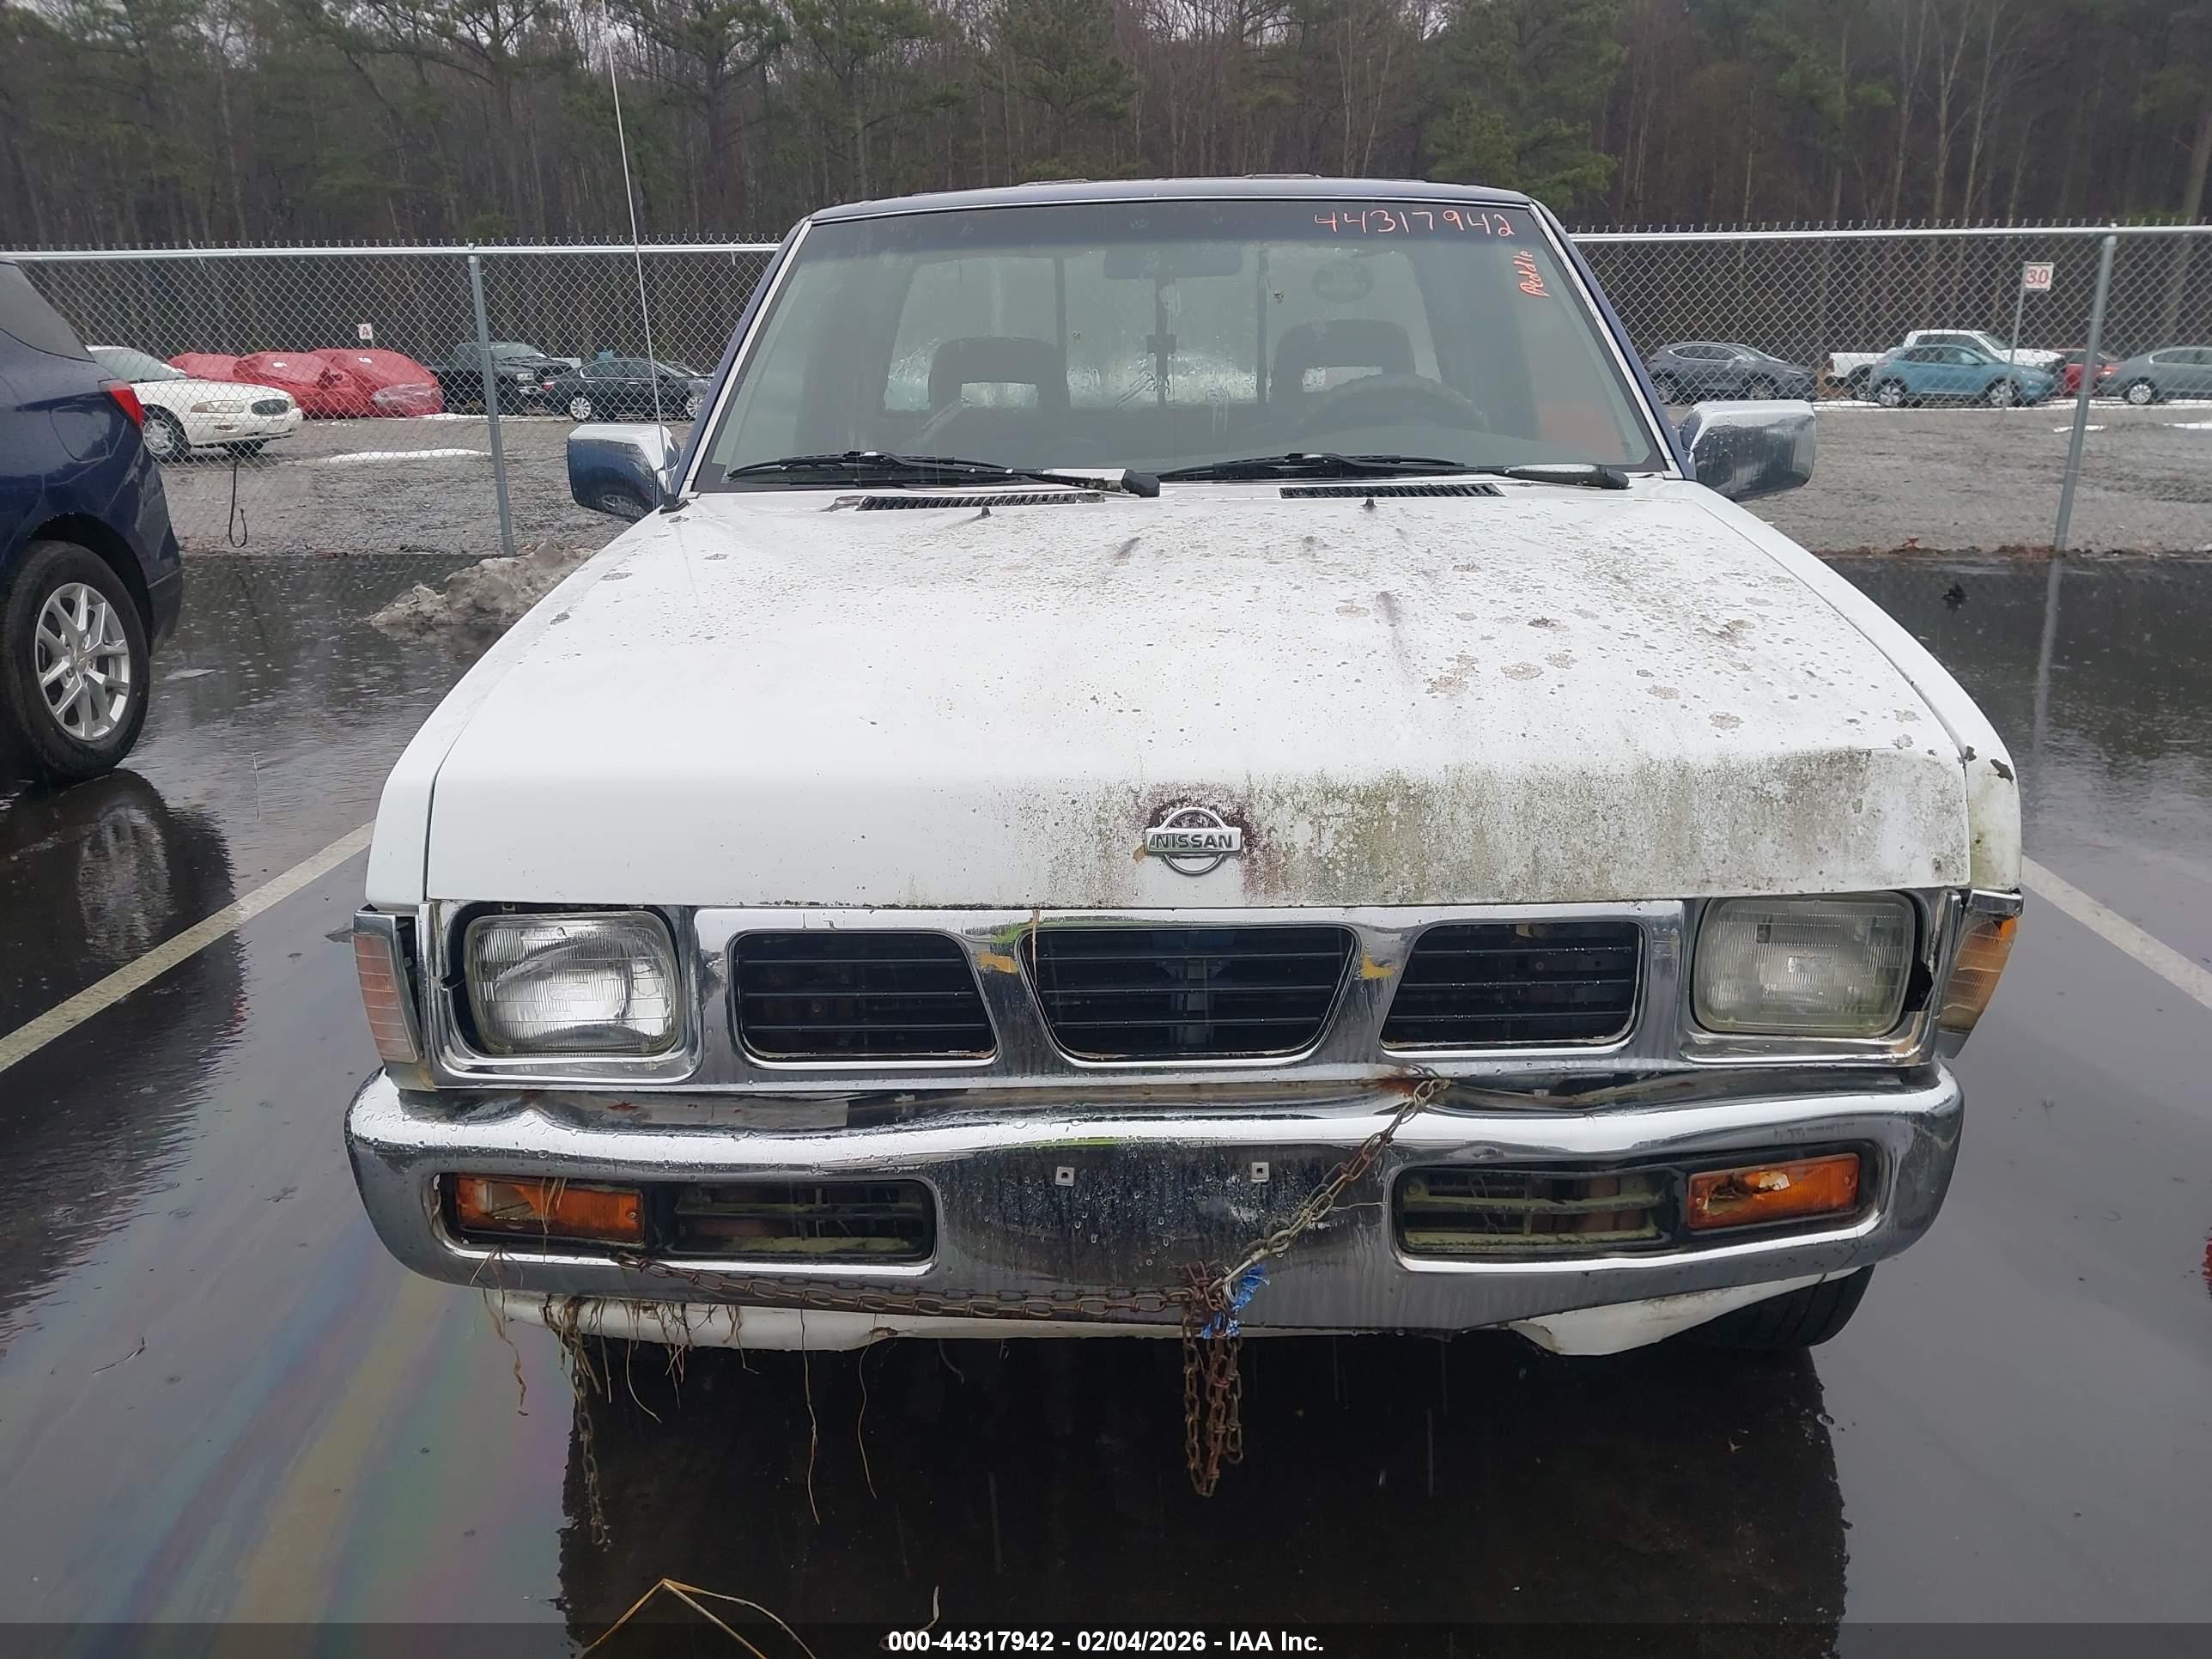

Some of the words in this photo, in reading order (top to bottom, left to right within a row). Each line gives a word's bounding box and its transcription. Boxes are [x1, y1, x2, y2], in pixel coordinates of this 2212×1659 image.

[1315, 210, 1516, 237] 44317942
[2026, 269, 2049, 284] 30
[362, 325, 370, 337] A
[1155, 833, 1232, 848] NISSAN
